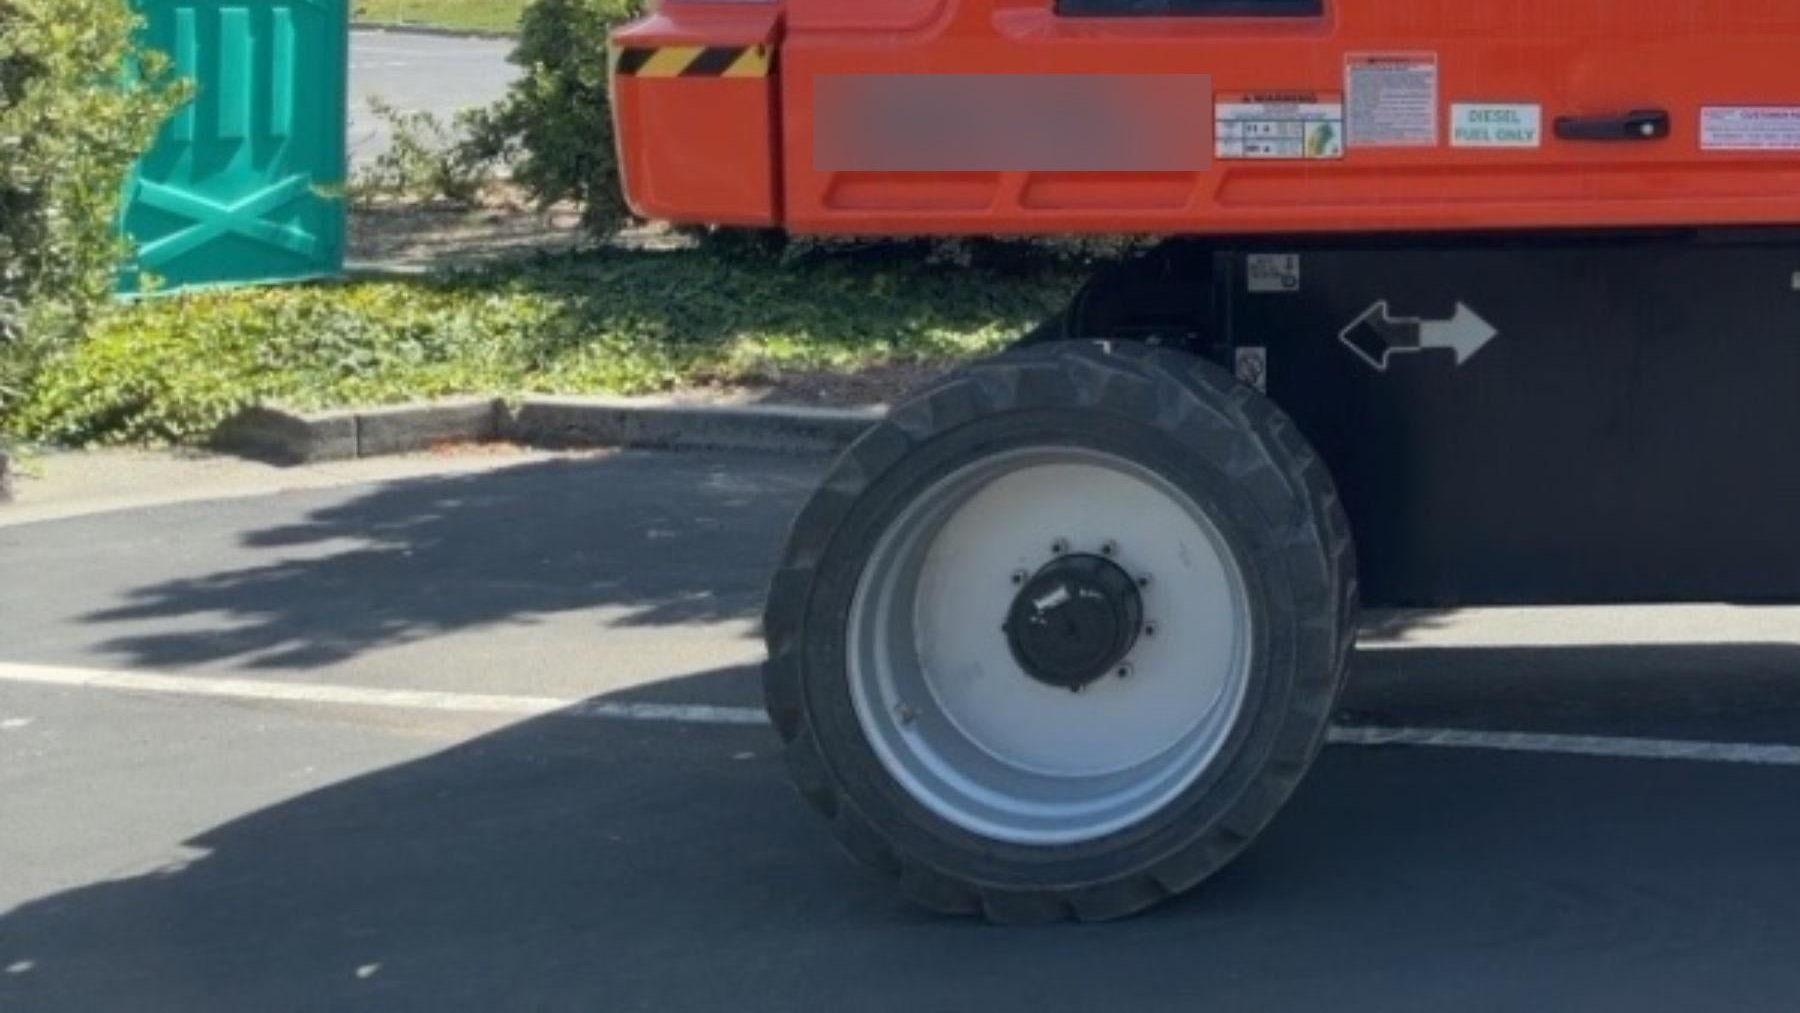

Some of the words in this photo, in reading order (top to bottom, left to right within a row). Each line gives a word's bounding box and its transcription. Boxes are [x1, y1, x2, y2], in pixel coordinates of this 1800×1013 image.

[1468, 109, 1522, 124] DIESEL
[1454, 128, 1490, 142] FUEL
[1494, 128, 1536, 142] ONLY
